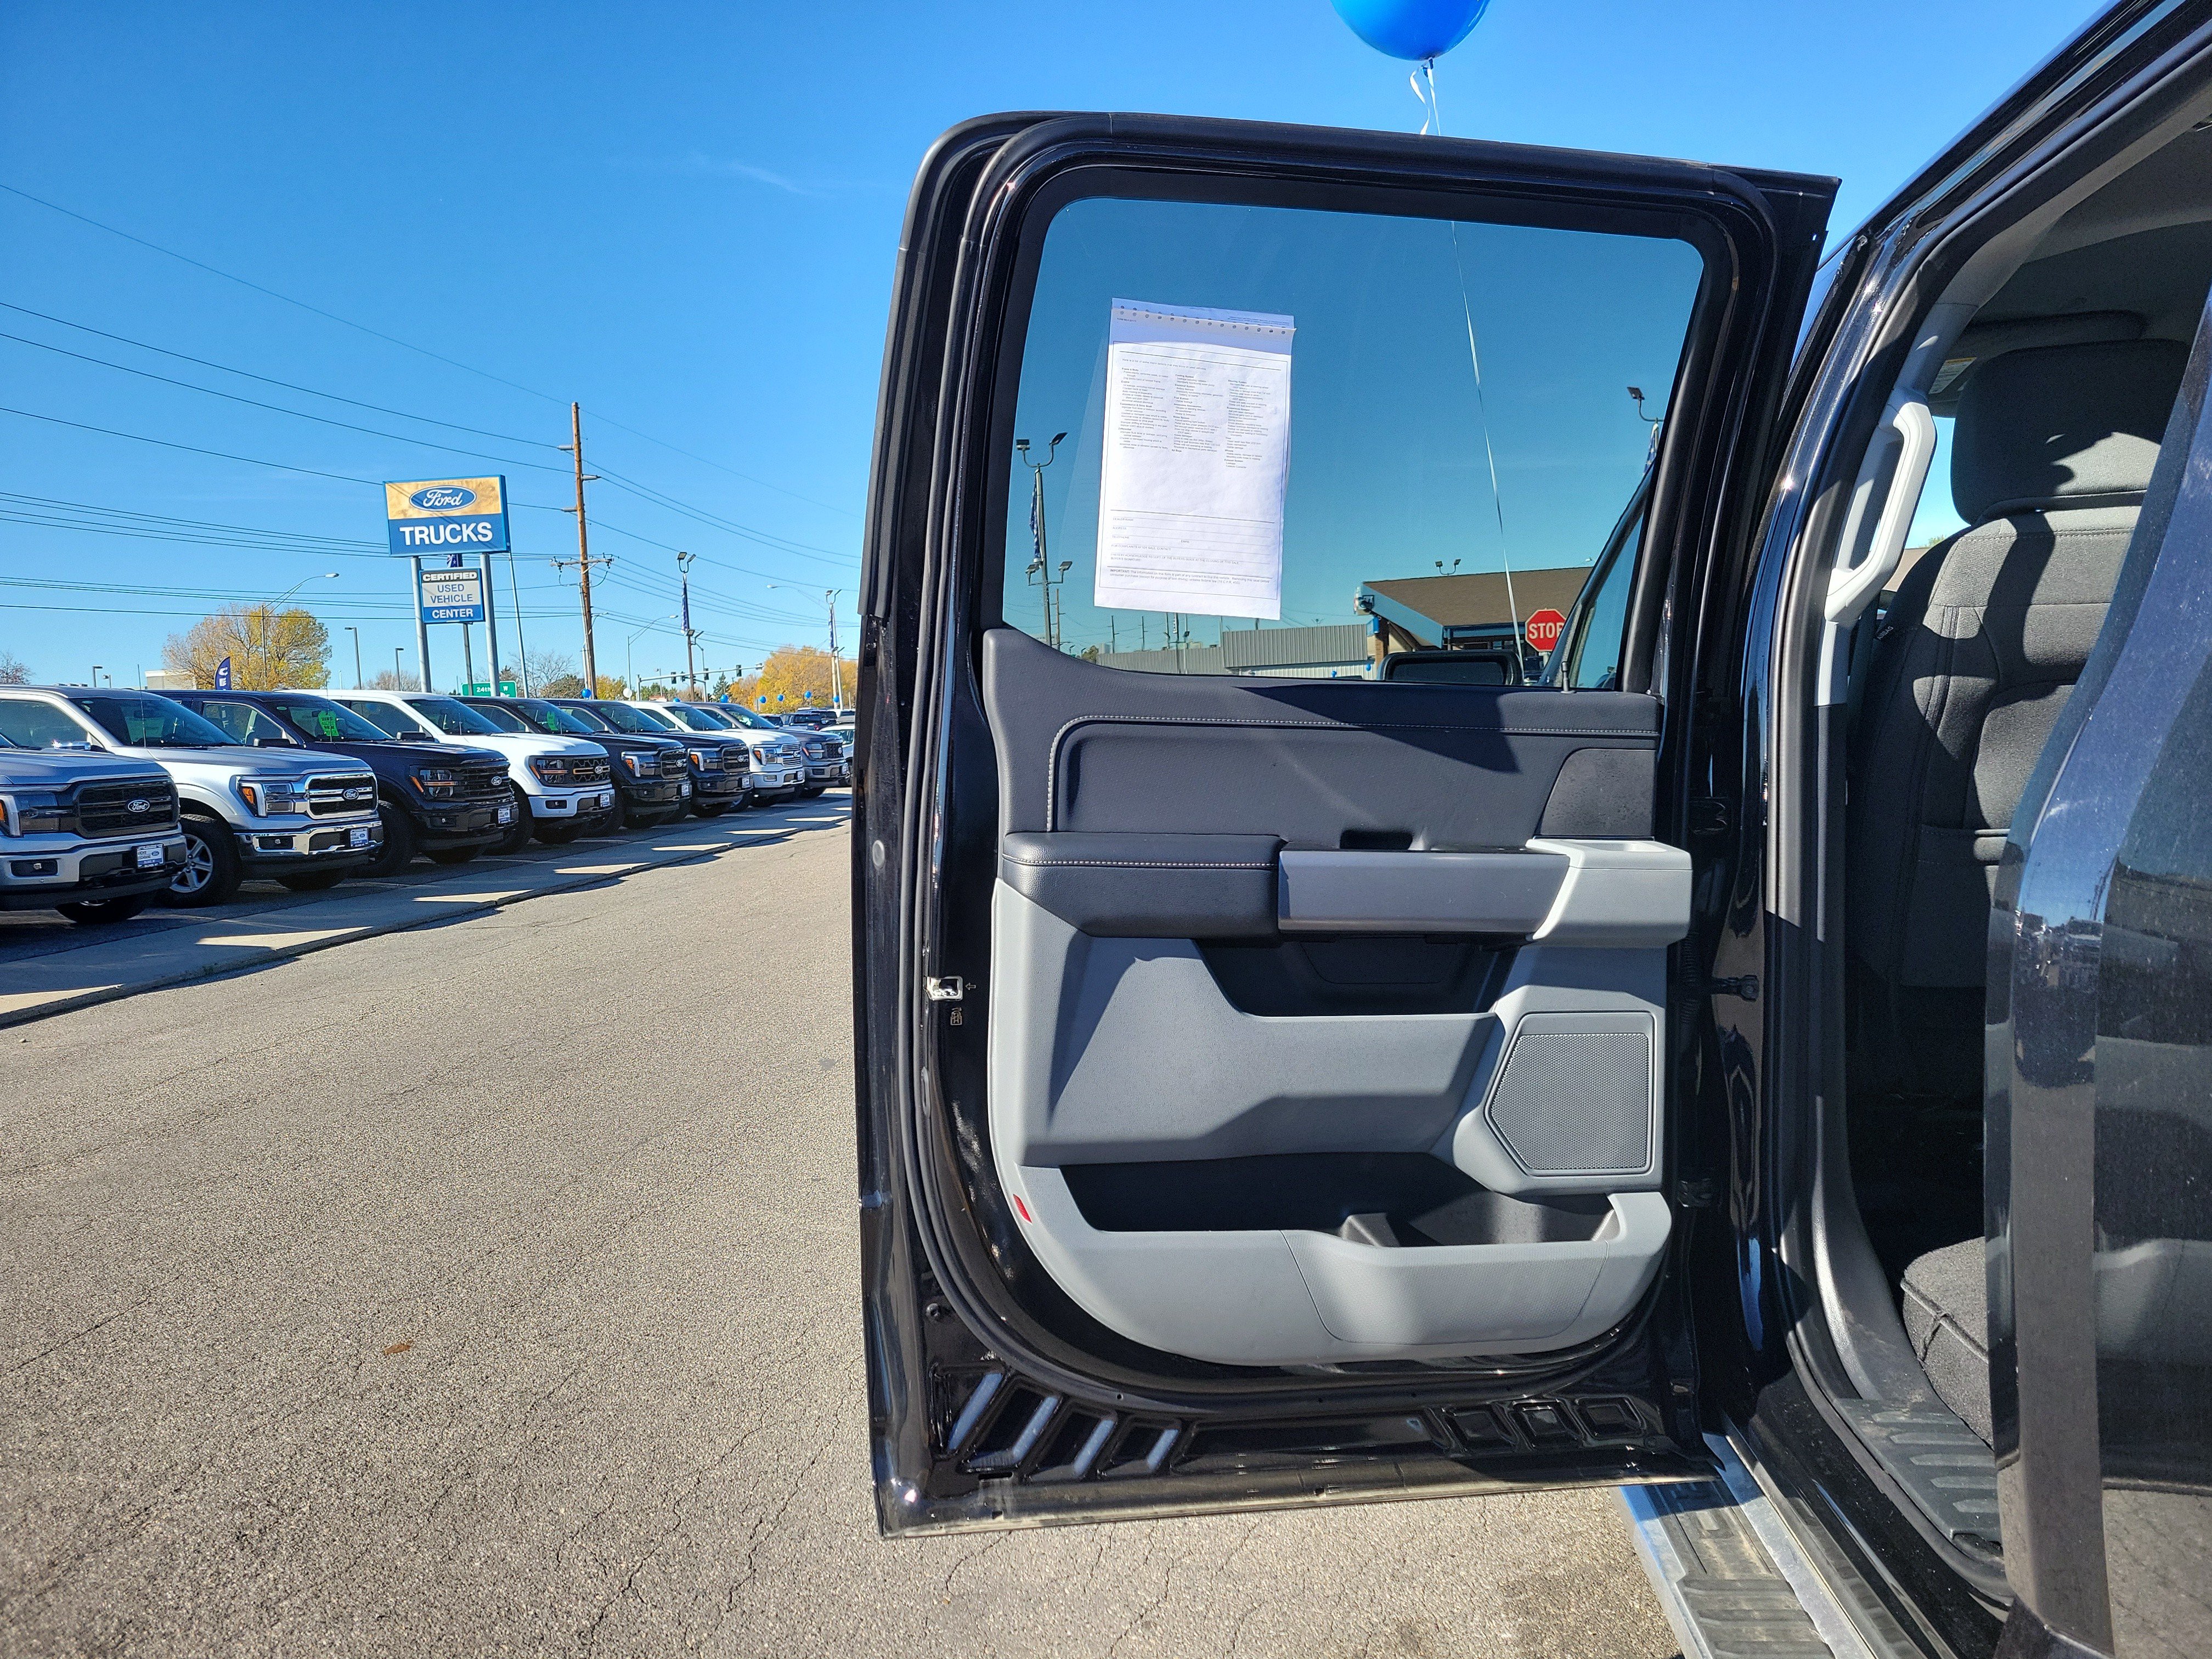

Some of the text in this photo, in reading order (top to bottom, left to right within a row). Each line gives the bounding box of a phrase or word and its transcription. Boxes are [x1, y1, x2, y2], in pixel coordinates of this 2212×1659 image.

[423, 489, 463, 507] Ford
[399, 522, 493, 545] TRUCKS
[422, 572, 477, 582] CERTIFIED
[437, 584, 465, 592] USED
[430, 594, 473, 603] VEHICLE
[432, 608, 473, 619] CENTER
[1528, 622, 1564, 639] STOP
[132, 802, 148, 810] Ford
